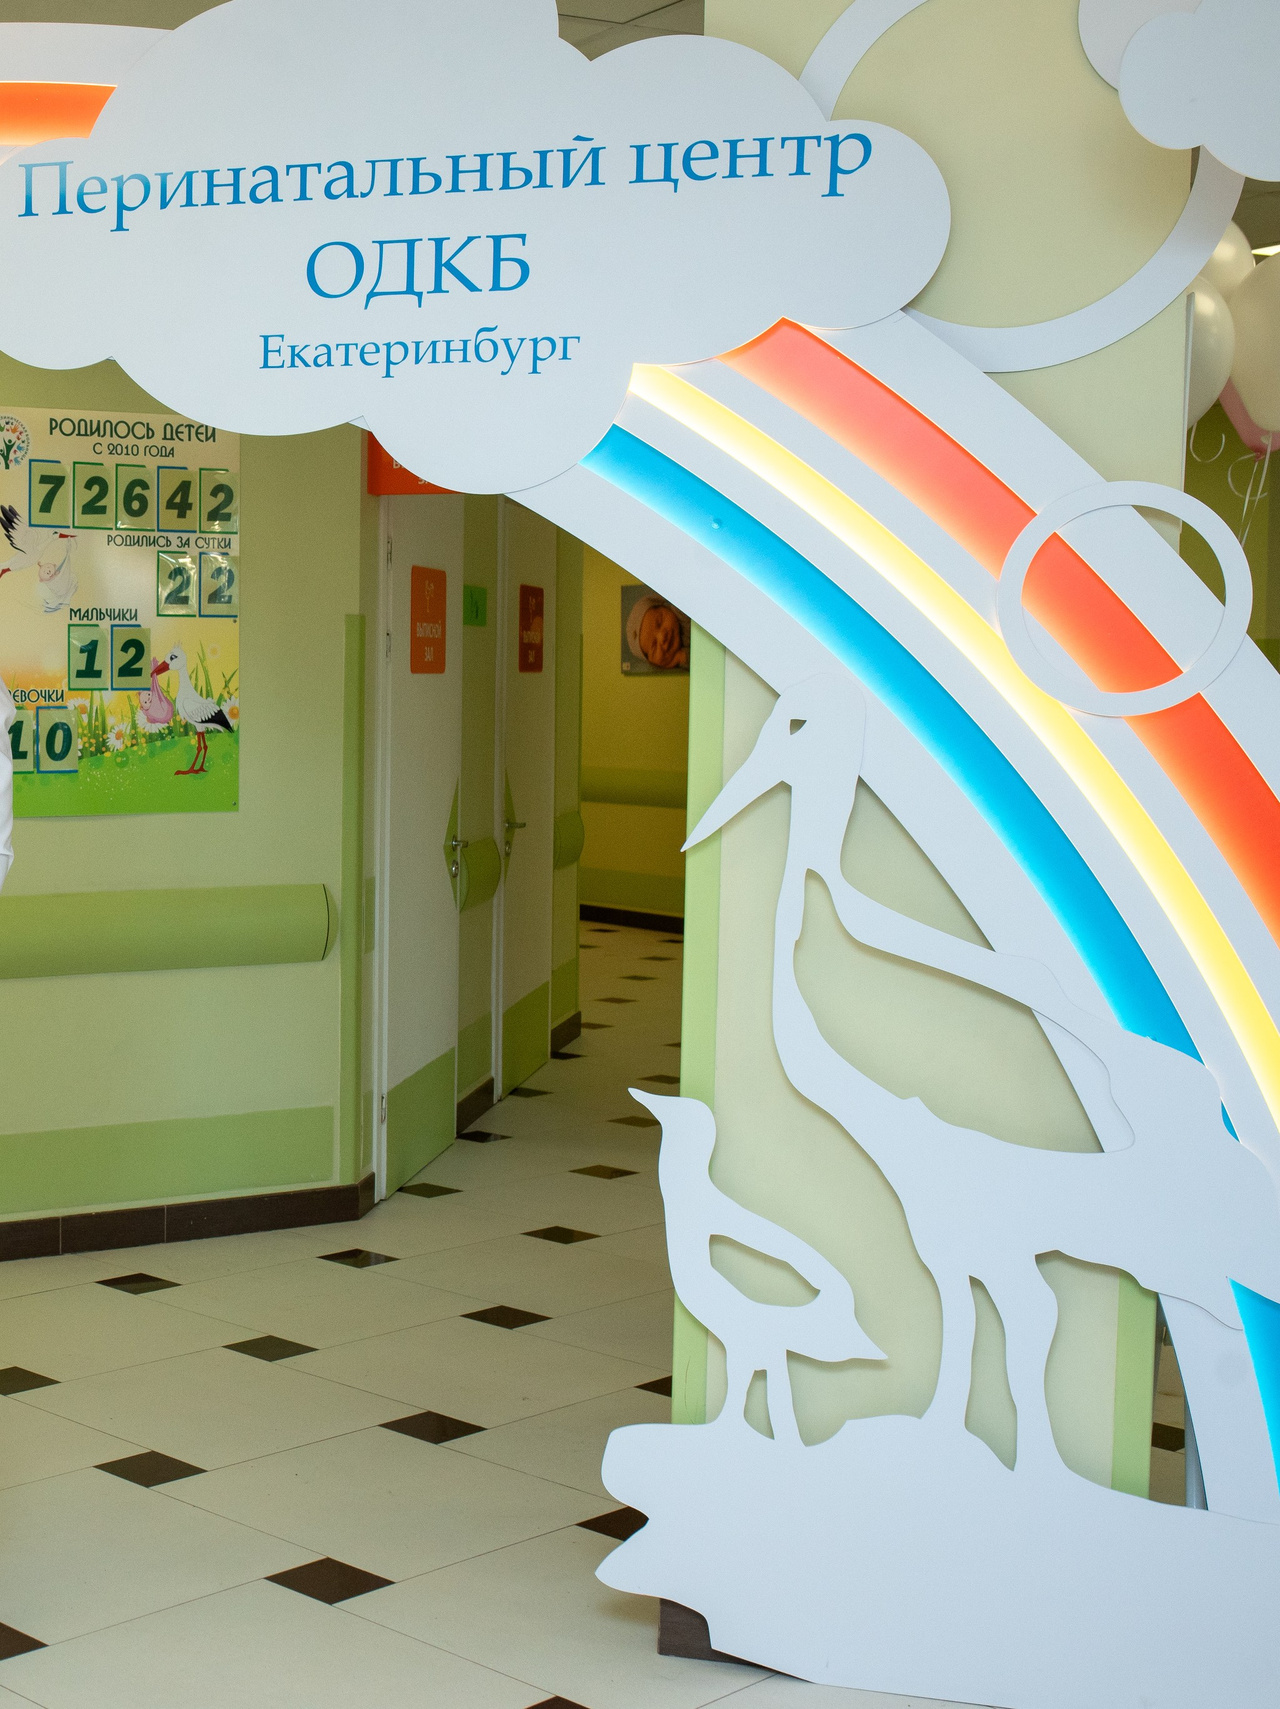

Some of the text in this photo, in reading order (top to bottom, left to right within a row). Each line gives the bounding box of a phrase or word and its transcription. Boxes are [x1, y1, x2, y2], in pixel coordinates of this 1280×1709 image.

[18, 132, 873, 233] Перинатальный центр
[306, 232, 531, 310] ОДКБ
[259, 325, 581, 379] Екатеринбург
[49, 417, 155, 440] РОДИЛОСЬ
[92, 442, 175, 458] С 2010 ГОДА
[107, 534, 231, 549] РОДИЛИСЬ ЗА СУТКИ
[69, 607, 138, 622] МАЛЬЧИКИ
[8, 689, 64, 703] ЕВОЧКИ
